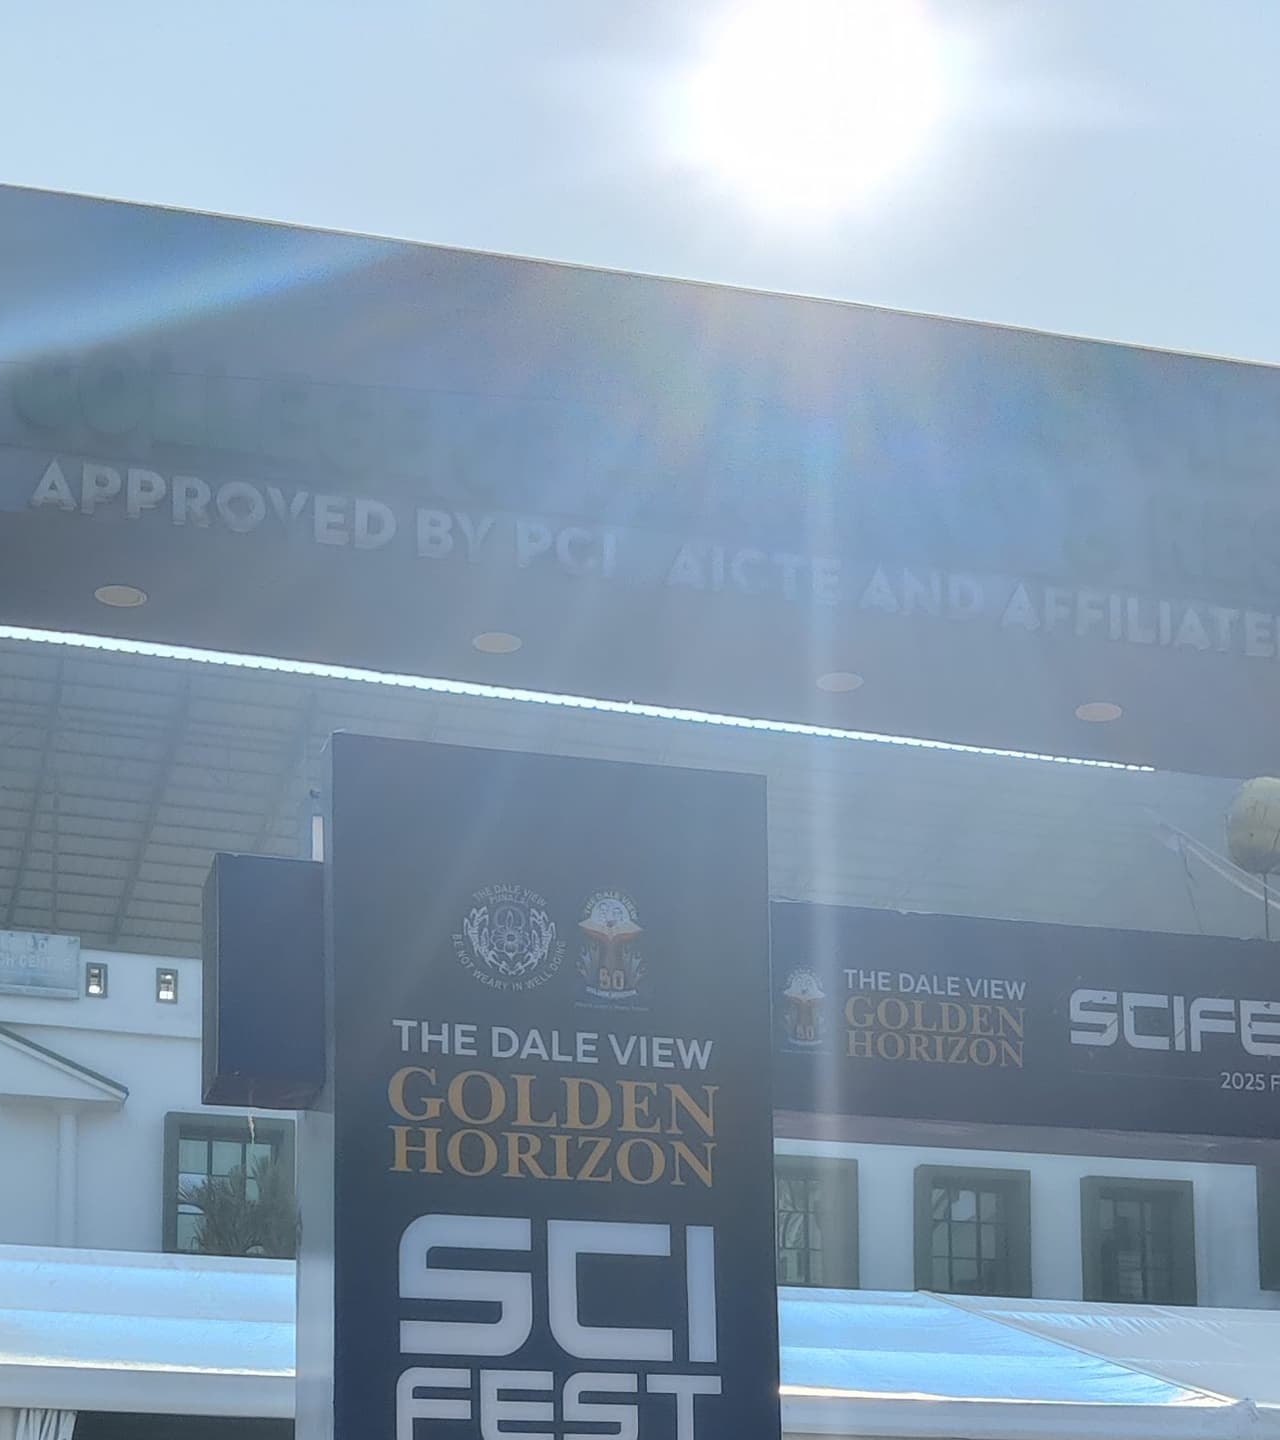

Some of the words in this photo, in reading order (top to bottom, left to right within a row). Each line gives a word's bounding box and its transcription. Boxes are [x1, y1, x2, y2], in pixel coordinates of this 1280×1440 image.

[30, 456, 398, 554] APPROVED
[417, 505, 498, 570] BY
[663, 540, 844, 606] AICTE
[861, 565, 986, 622] AND
[843, 968, 892, 992] THE
[899, 972, 962, 997] DALE
[965, 977, 1027, 1001] VIEW
[844, 995, 1027, 1039] GOLDEN
[392, 1019, 478, 1056] THE
[490, 1025, 600, 1065] DALE
[608, 1033, 714, 1071] VIEW
[846, 1030, 1026, 1070] HORIZON
[387, 1066, 720, 1138] GOLDEN
[1220, 1071, 1267, 1093] 2025
[388, 1125, 718, 1189] HORIZON
[399, 1214, 718, 1363] SCI
